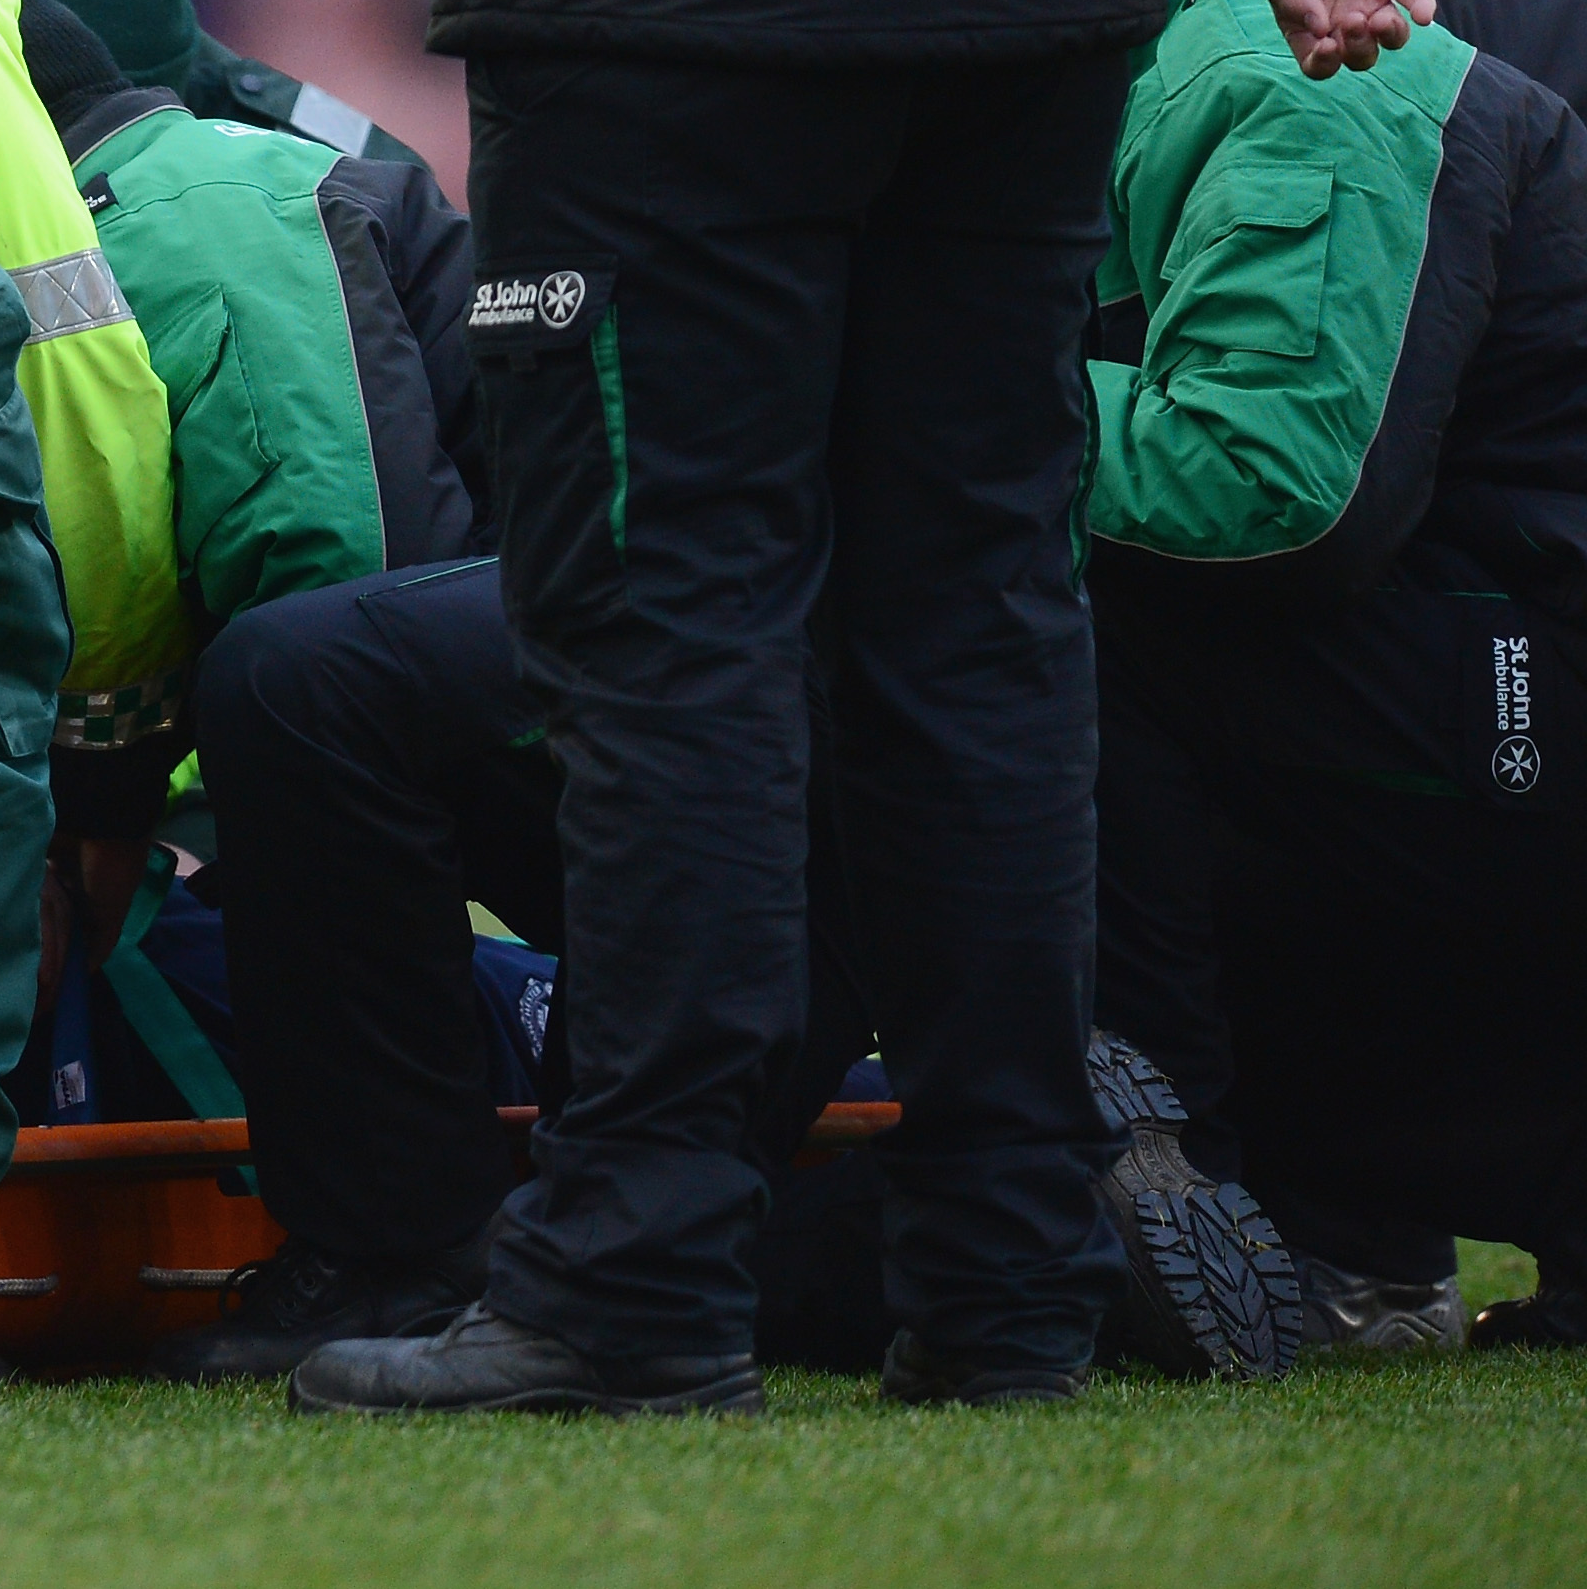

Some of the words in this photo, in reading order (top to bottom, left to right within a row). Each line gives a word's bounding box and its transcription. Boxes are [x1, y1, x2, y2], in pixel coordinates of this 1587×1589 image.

[473, 283, 493, 310] St
[493, 279, 538, 308] John
[468, 307, 535, 327] Ambulance
[1509, 636, 1529, 664] St
[1493, 637, 1511, 731] Ambulance
[1512, 667, 1531, 730] John
